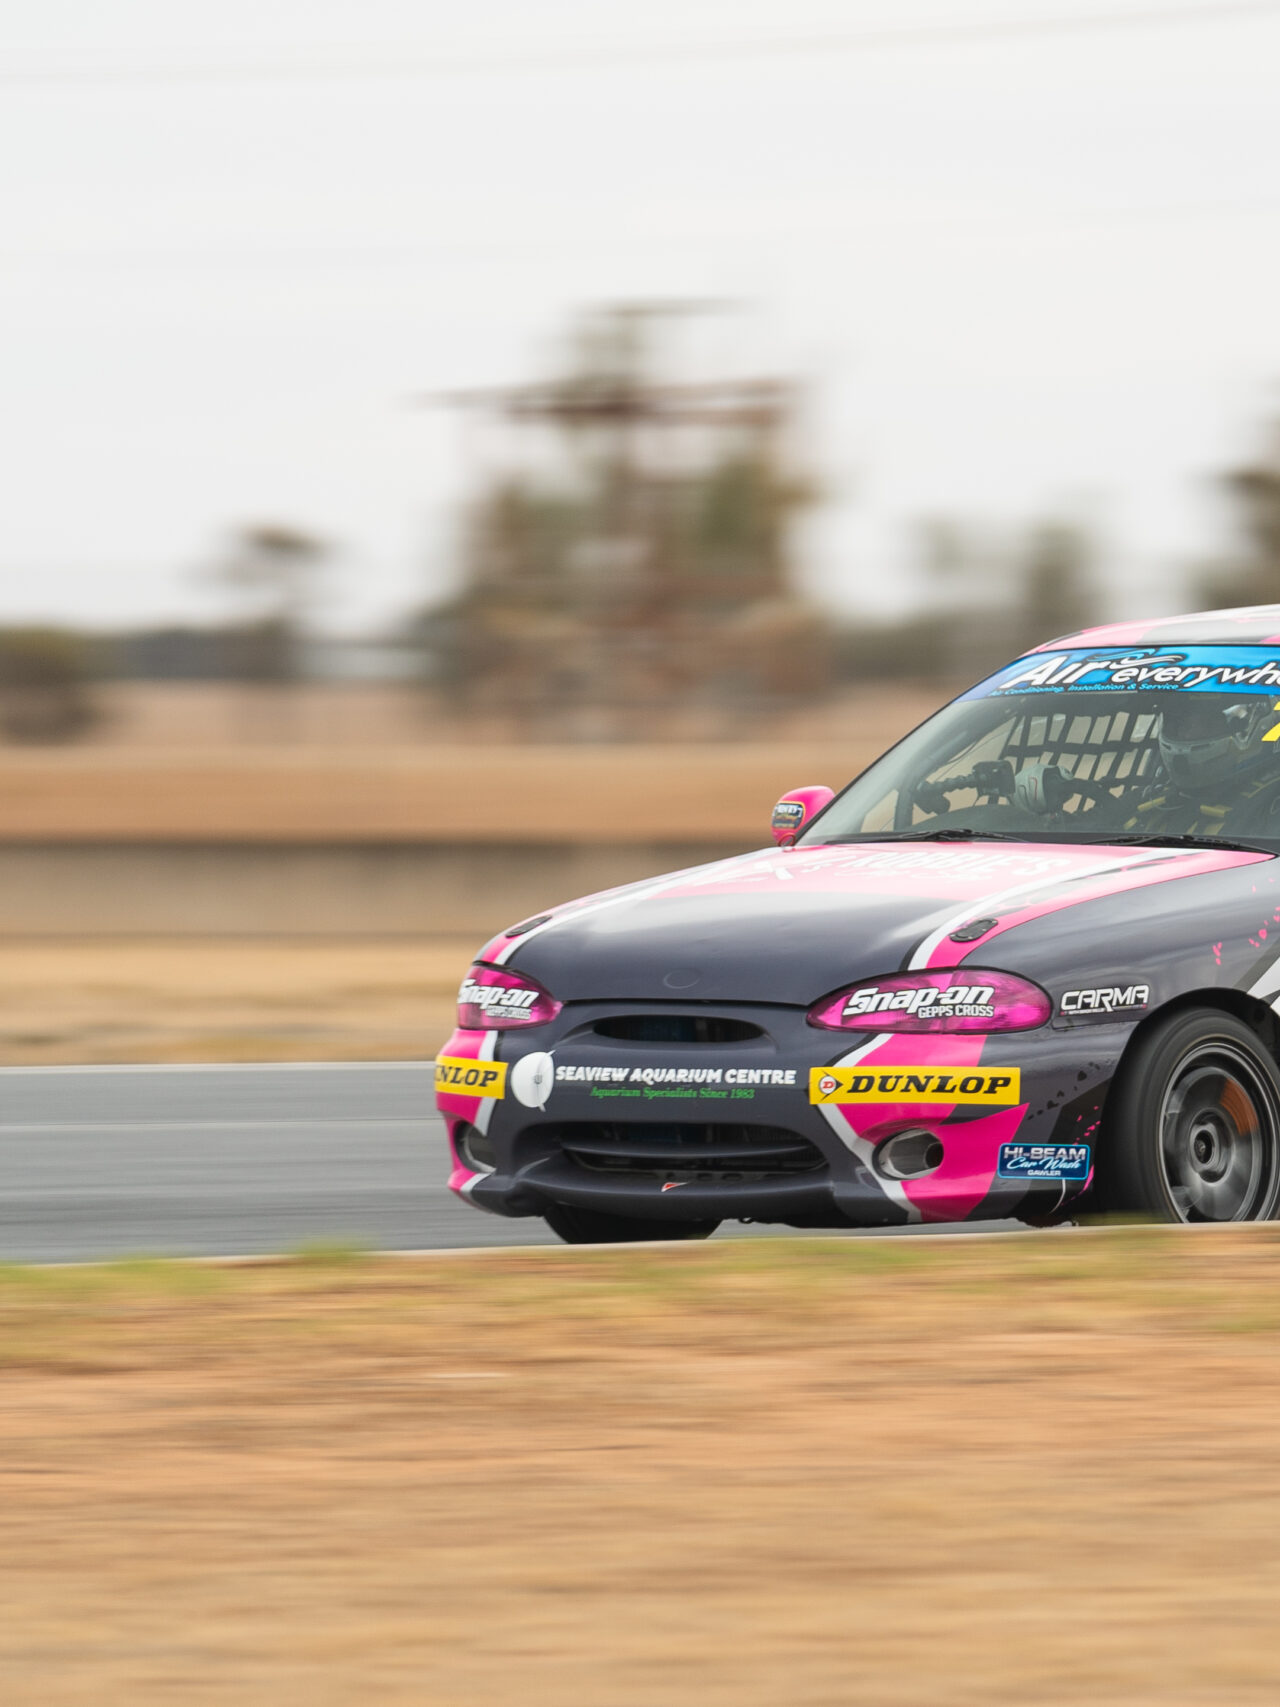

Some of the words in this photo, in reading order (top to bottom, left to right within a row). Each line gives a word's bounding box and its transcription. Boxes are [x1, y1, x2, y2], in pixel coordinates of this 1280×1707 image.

[999, 655, 1111, 689] Air
[457, 978, 540, 1010] Snap-on
[842, 986, 995, 1016] Snap-on
[1061, 984, 1150, 1012] CARMA
[918, 1005, 954, 1018] GEPPS
[955, 1004, 995, 1017] CROSS
[436, 1065, 498, 1088] NLOP
[555, 1066, 629, 1082] SEAVIEW
[630, 1067, 723, 1085] AQUARIUM
[724, 1069, 797, 1085] CENTRE
[847, 1074, 1012, 1095] DUNLOP
[590, 1087, 641, 1099] Aquarium
[699, 1088, 728, 1098] Since
[1003, 1146, 1086, 1160] HI-BEAM
[1006, 1156, 1037, 1169] Car
[1038, 1156, 1082, 1170] Wash
